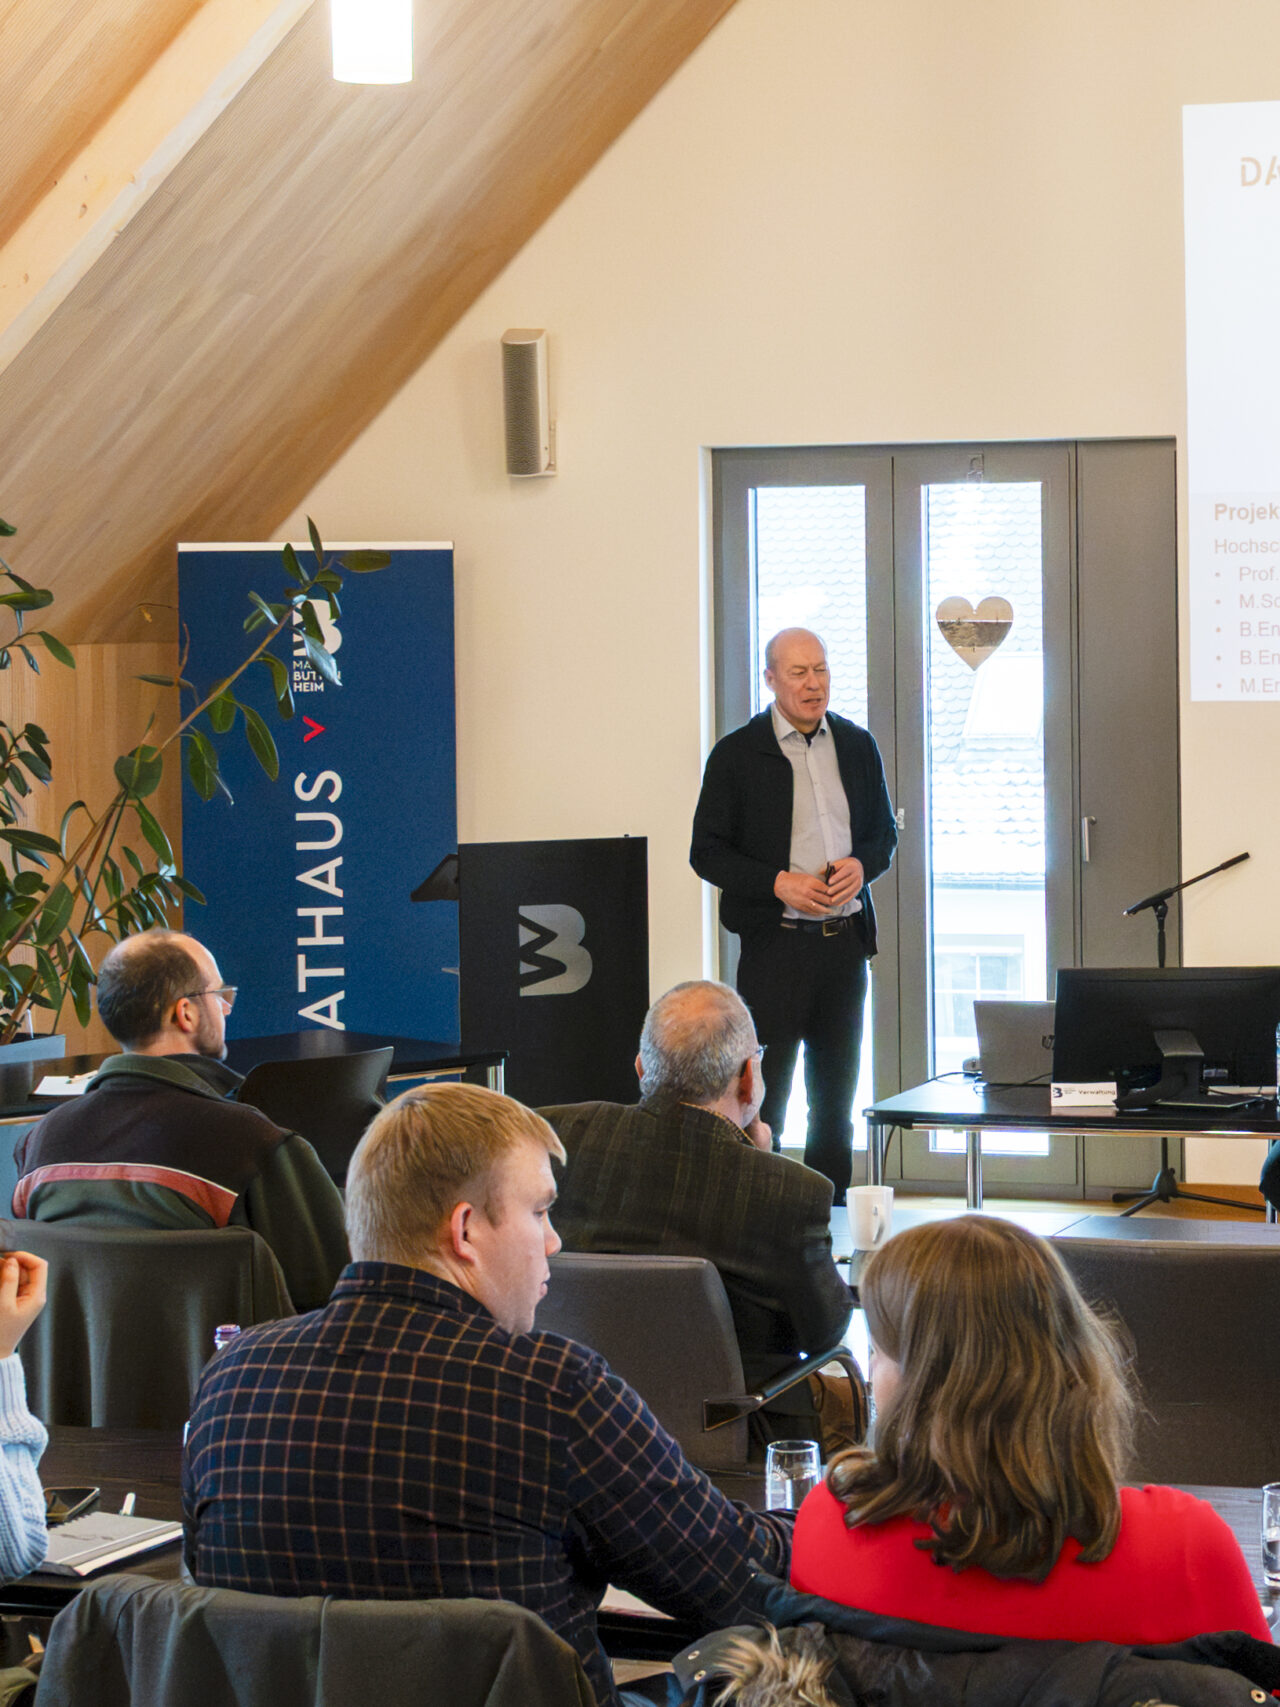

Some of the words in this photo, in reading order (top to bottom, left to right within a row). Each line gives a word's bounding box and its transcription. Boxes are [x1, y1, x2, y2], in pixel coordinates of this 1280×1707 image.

[1238, 565, 1280, 582] Prof.
[293, 681, 325, 693] HEIM
[294, 770, 346, 1031] ATHAUS
